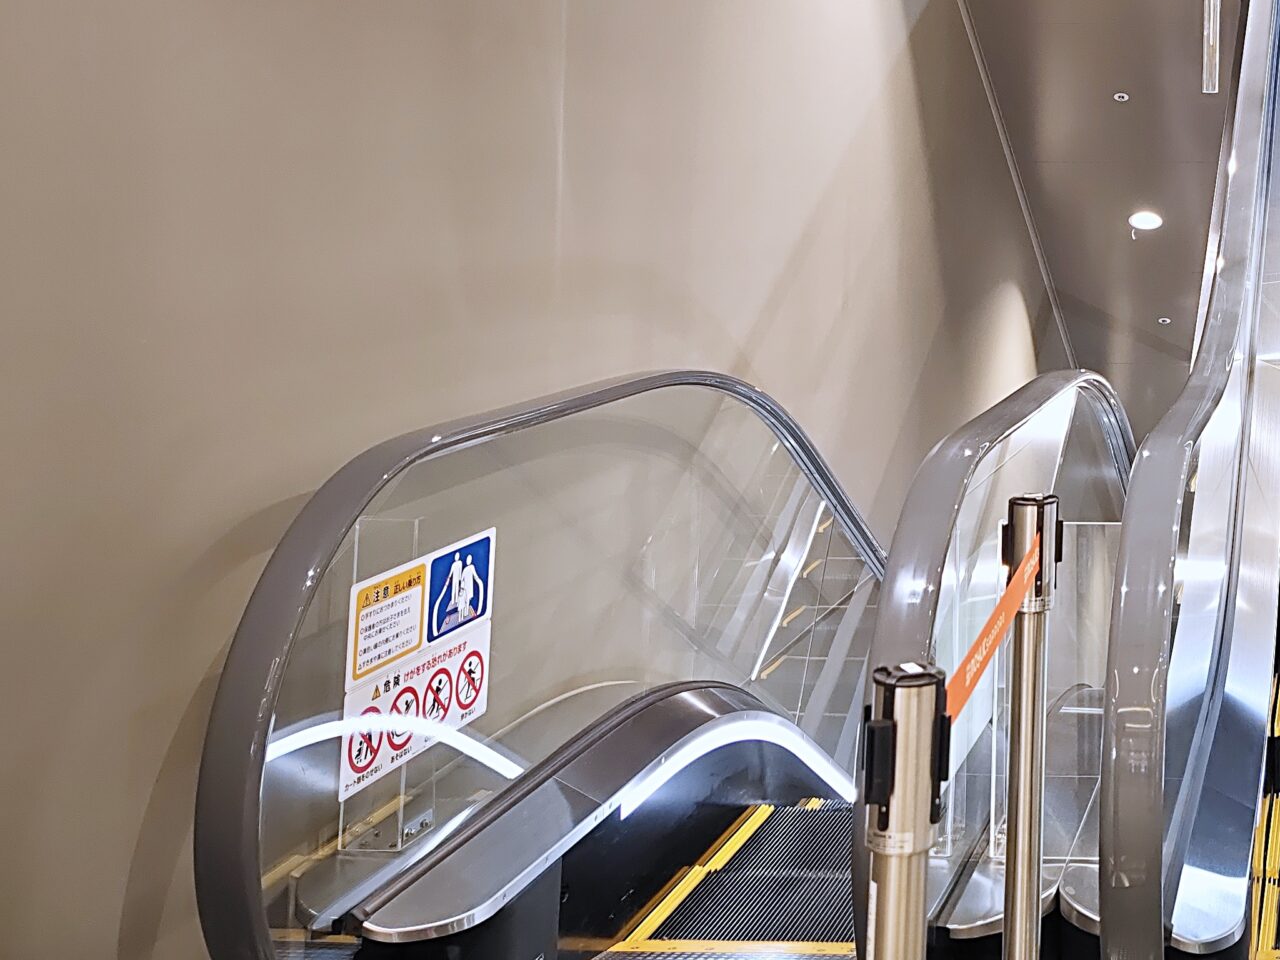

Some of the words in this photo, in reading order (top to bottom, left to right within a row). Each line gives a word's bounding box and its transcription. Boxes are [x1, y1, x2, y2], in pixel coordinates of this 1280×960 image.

[373, 584, 389, 603] 注意
[383, 672, 400, 694] 危険
[403, 639, 467, 683] けがをする恐れがあります
